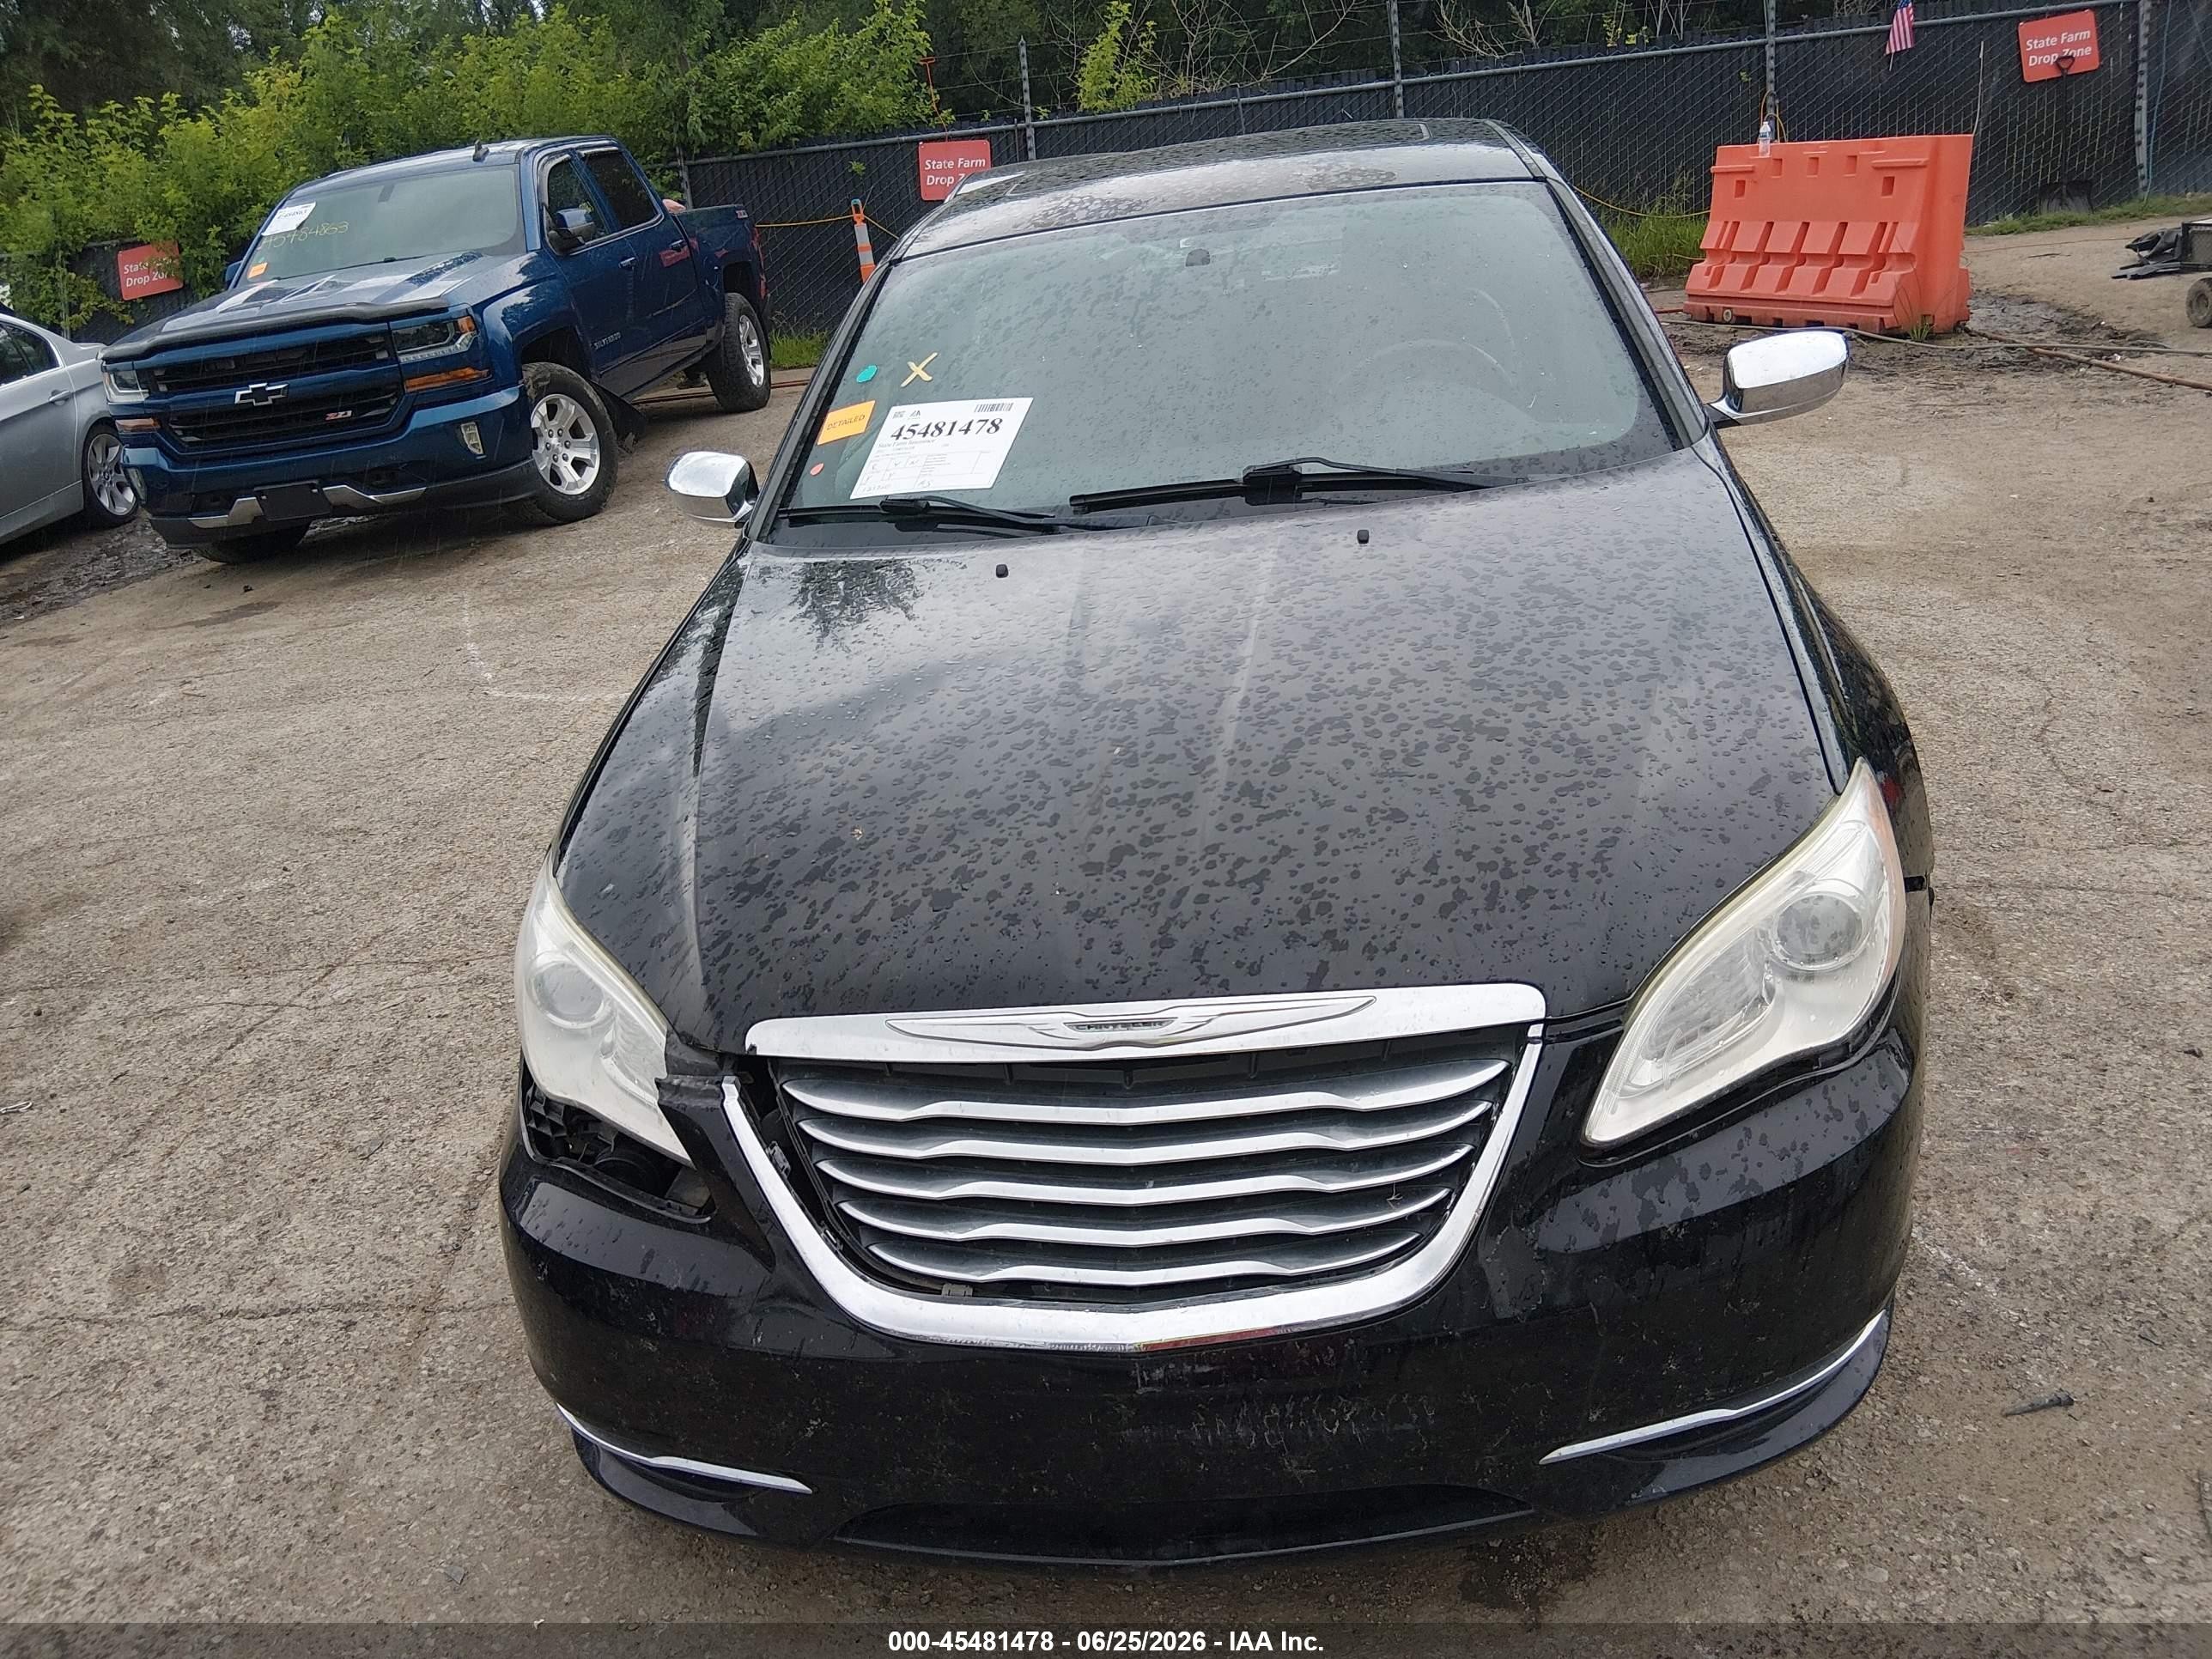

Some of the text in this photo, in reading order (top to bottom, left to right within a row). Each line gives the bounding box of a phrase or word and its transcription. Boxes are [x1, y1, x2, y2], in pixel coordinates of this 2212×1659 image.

[2026, 30, 2090, 51] State Farm
[2028, 53, 2058, 66] Drop
[924, 157, 986, 170] State Farm
[926, 175, 955, 187] Drop
[126, 275, 150, 288] Drop
[827, 415, 866, 431] DETAILED
[890, 417, 1003, 441] 45481478
